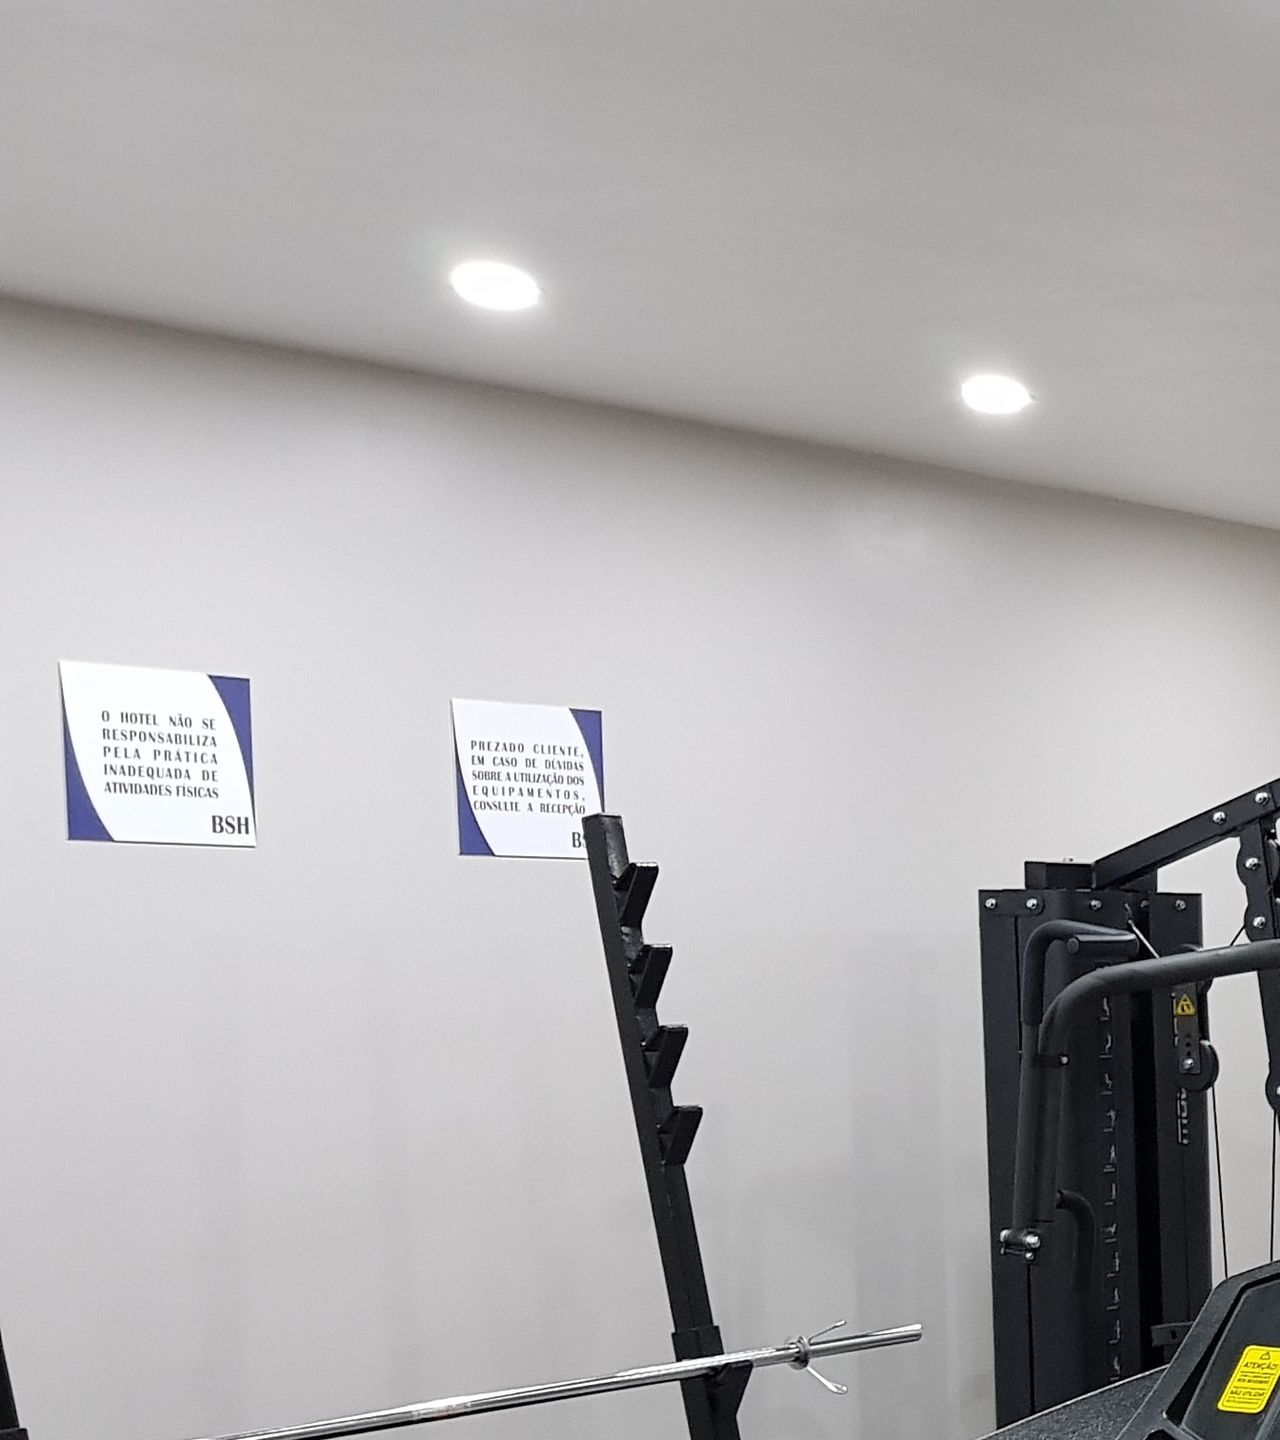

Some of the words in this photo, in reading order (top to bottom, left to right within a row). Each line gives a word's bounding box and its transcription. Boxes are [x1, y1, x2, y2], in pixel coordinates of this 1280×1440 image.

[102, 711, 110, 722] O
[120, 711, 159, 726] HOTEL
[169, 714, 192, 728] NÃO
[202, 718, 216, 730] SE
[102, 728, 217, 748] RESPONSABILIZA
[470, 740, 525, 753] PREZADO
[103, 746, 141, 760] PELA
[153, 748, 218, 765] PRÁTICA
[471, 755, 484, 766] EM
[493, 756, 518, 768] CASO
[525, 758, 537, 769] DE
[545, 757, 584, 771] DÚVIDAS
[104, 763, 191, 781] INADEQUADA
[202, 770, 218, 782] DE
[472, 770, 503, 782] SOBRE
[505, 771, 513, 782] A
[514, 772, 564, 786] UTILIZAÇÃO
[567, 775, 584, 786] DOS
[104, 782, 172, 796] ATIVIDADES
[176, 783, 219, 799] FÍSICAS
[474, 800, 521, 812] CONSULTE
[527, 801, 534, 812] A
[540, 802, 586, 817] RECEPÇÃO
[211, 815, 249, 835] BSH
